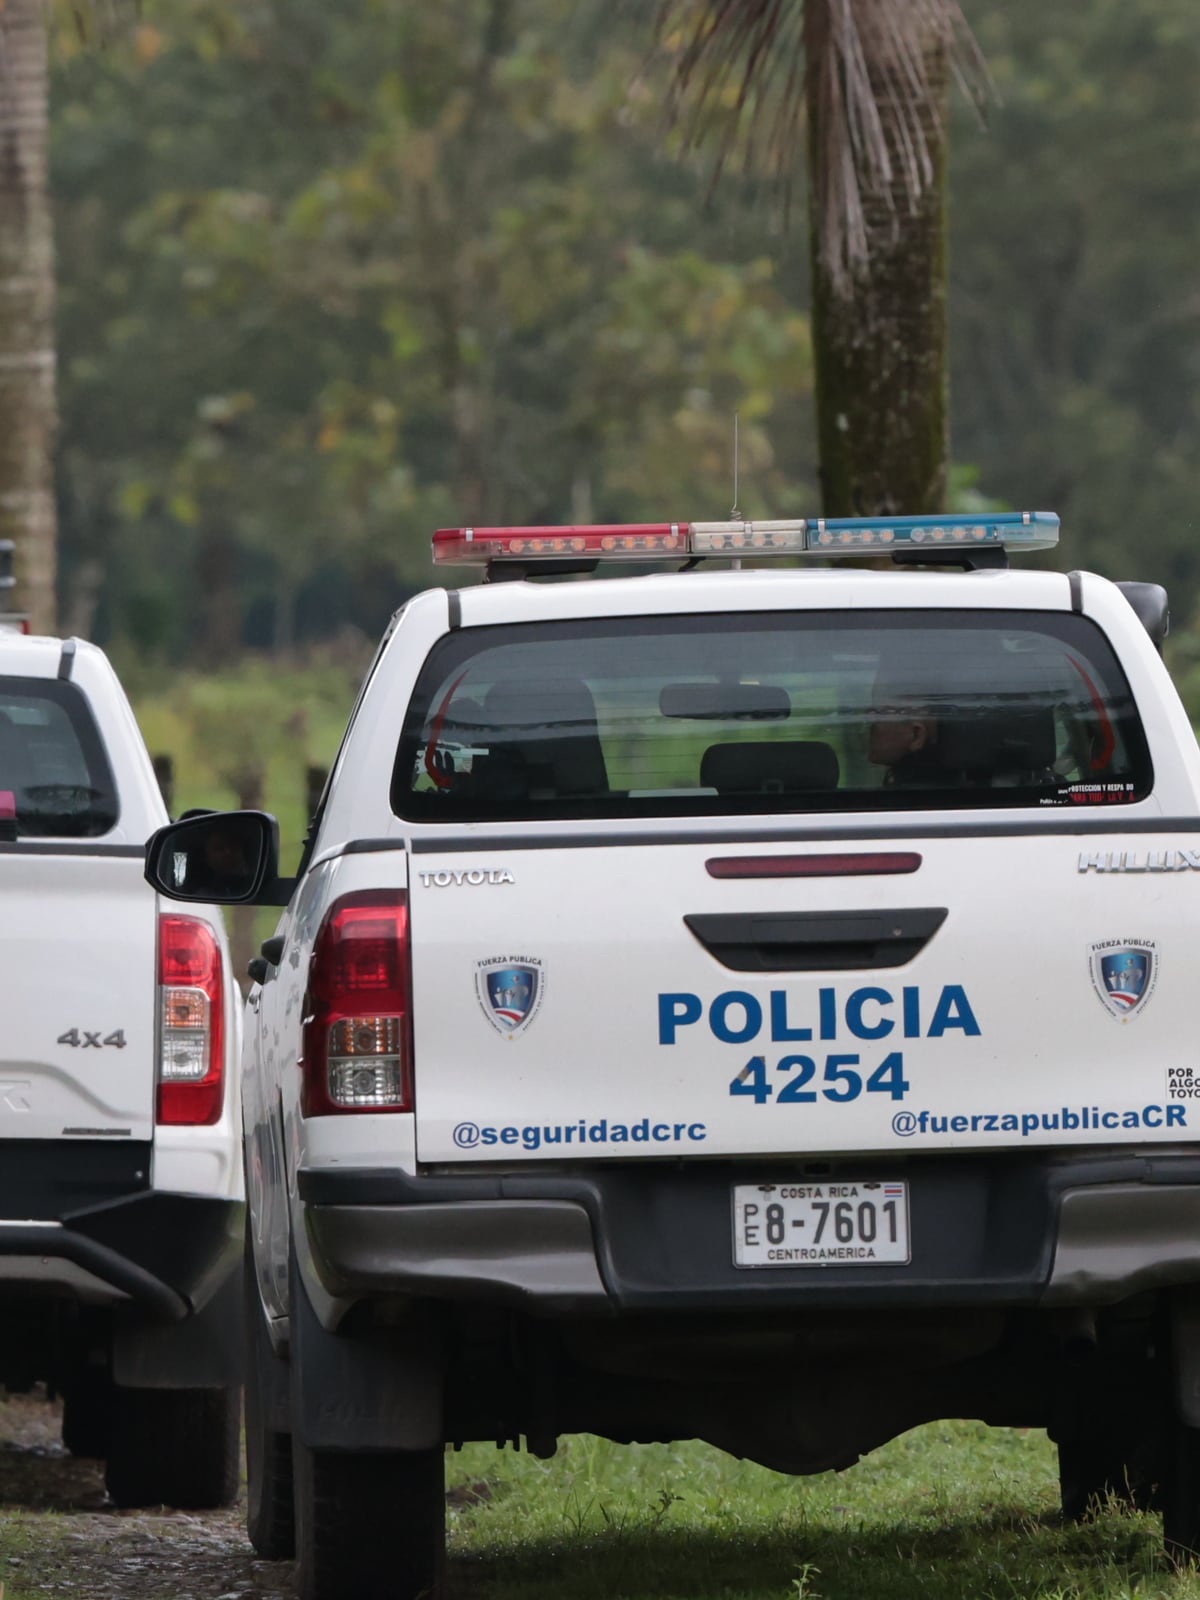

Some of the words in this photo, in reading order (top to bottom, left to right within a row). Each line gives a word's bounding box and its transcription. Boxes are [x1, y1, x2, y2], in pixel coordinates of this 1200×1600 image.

[1077, 851, 1200, 874] HILUX
[418, 867, 515, 888] TOYOTA
[1091, 939, 1121, 951] FUERZA
[1123, 938, 1156, 949] PUBLICA
[477, 955, 508, 968] FUERZA
[509, 955, 543, 967] PUBLICA
[657, 984, 982, 1045] POLICIA
[56, 1027, 127, 1049] 4x4
[729, 1052, 910, 1104] 4254
[1168, 1068, 1193, 1078] POR
[891, 1104, 1187, 1136] @fuerzapublicaCR
[452, 1118, 707, 1150] @seguridadcrc
[780, 1186, 824, 1199] COSTA
[829, 1186, 859, 1198] RICA
[766, 1201, 898, 1245] 8-7601
[767, 1248, 876, 1260] CENTROAMERICA
